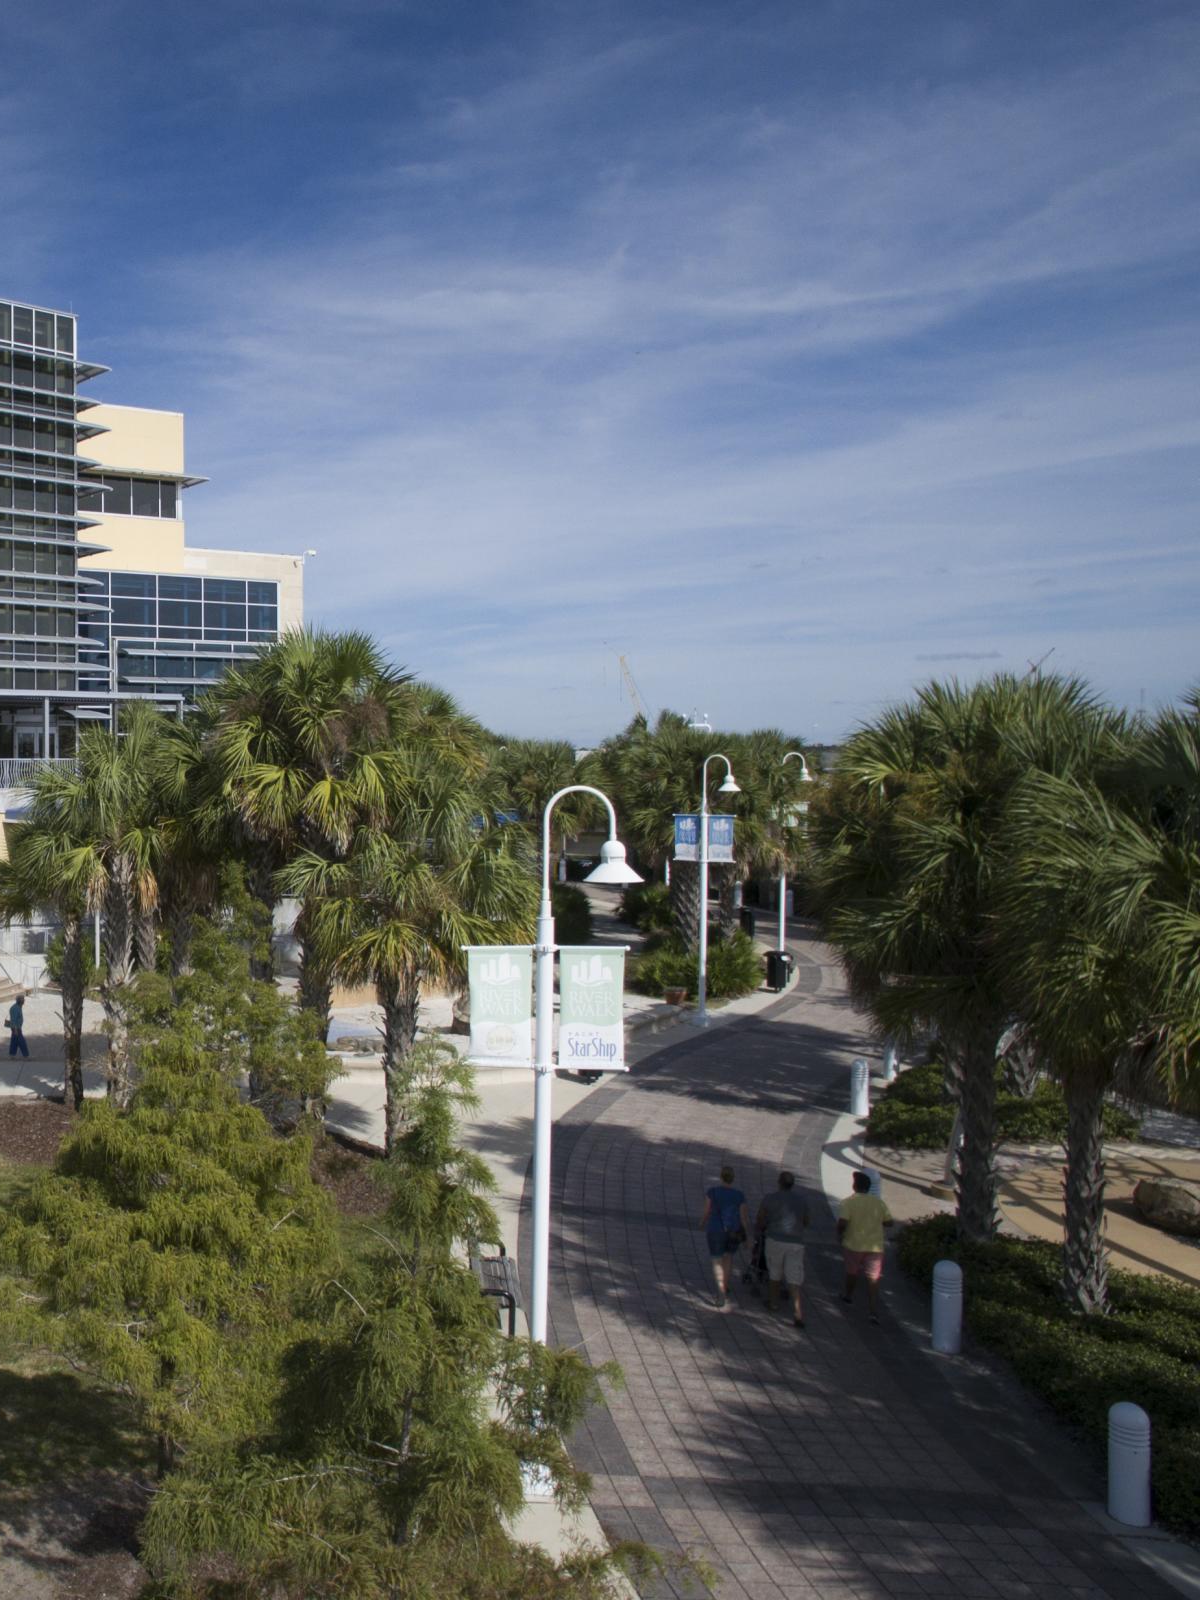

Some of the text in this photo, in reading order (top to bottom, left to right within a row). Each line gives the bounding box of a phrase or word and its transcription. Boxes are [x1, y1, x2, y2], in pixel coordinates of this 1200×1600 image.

[480, 989, 521, 1004] RIVER
[569, 991, 614, 1005] RIVER
[480, 1002, 522, 1016] WALK
[569, 1003, 615, 1017] WALK
[568, 1037, 617, 1062] StarShip
